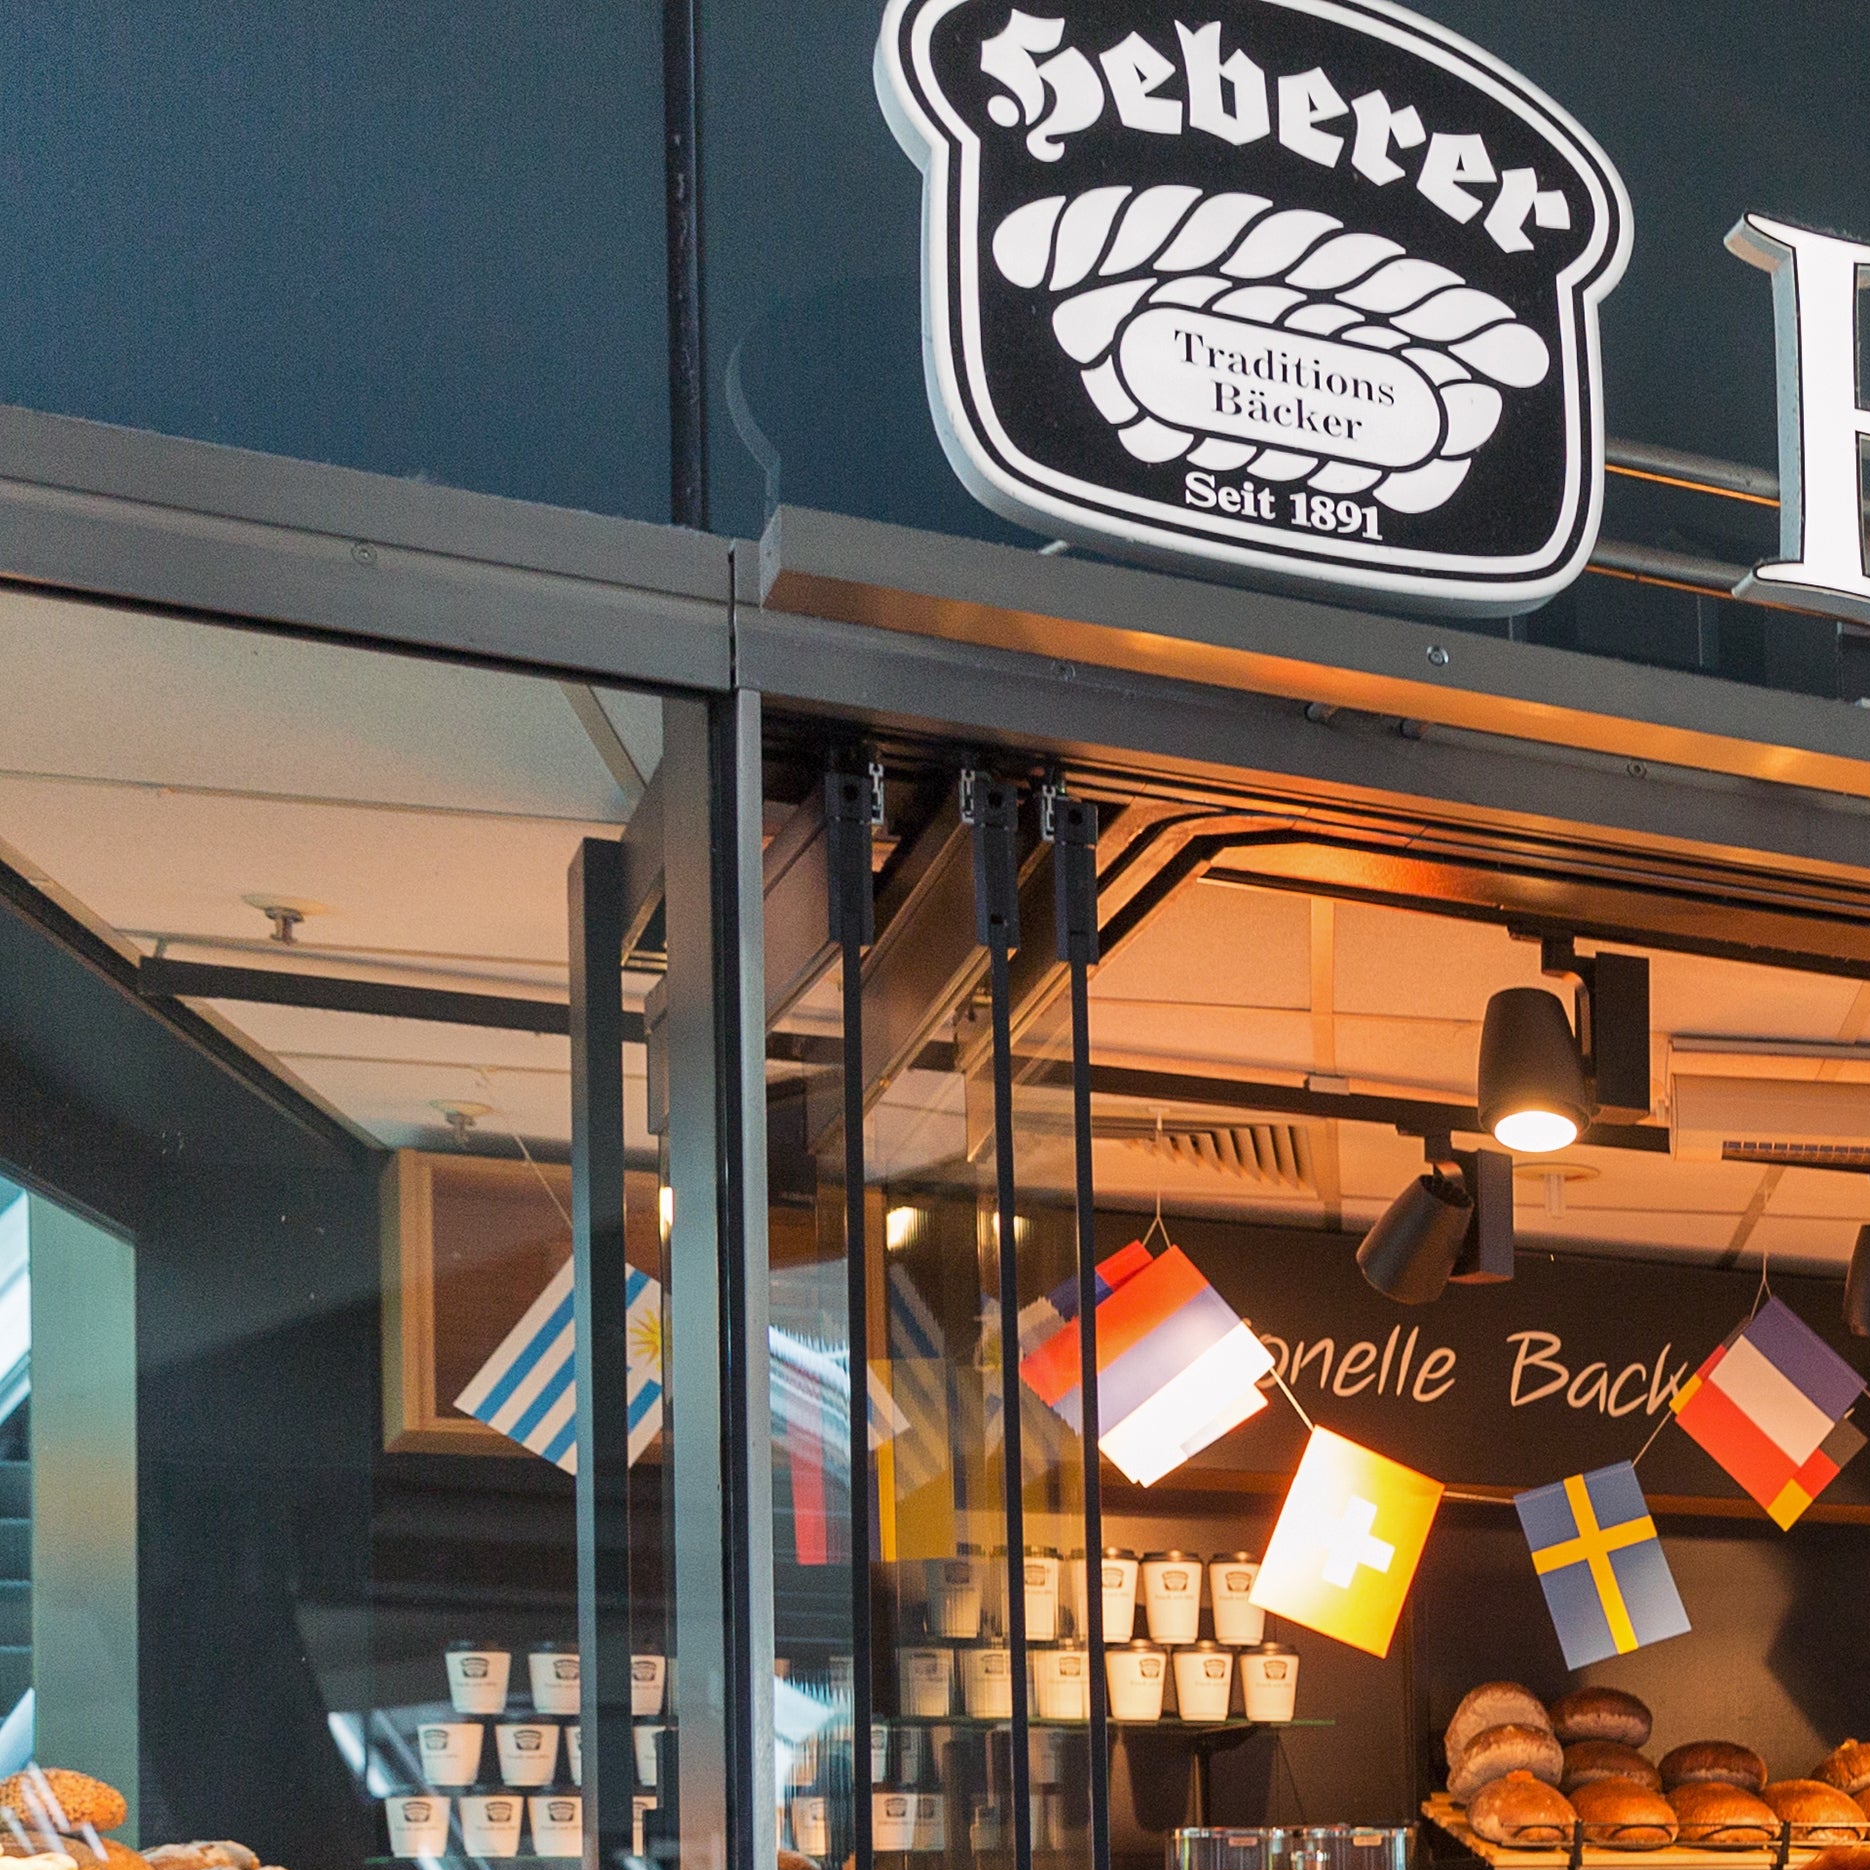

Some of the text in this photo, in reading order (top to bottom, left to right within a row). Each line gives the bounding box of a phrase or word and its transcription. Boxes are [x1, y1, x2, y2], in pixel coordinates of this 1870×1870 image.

[980, 8, 1571, 253] Heberer
[1173, 329, 1396, 408] Traditions
[1212, 380, 1364, 442] Bäcker
[1185, 471, 1384, 541] Seit 1891
